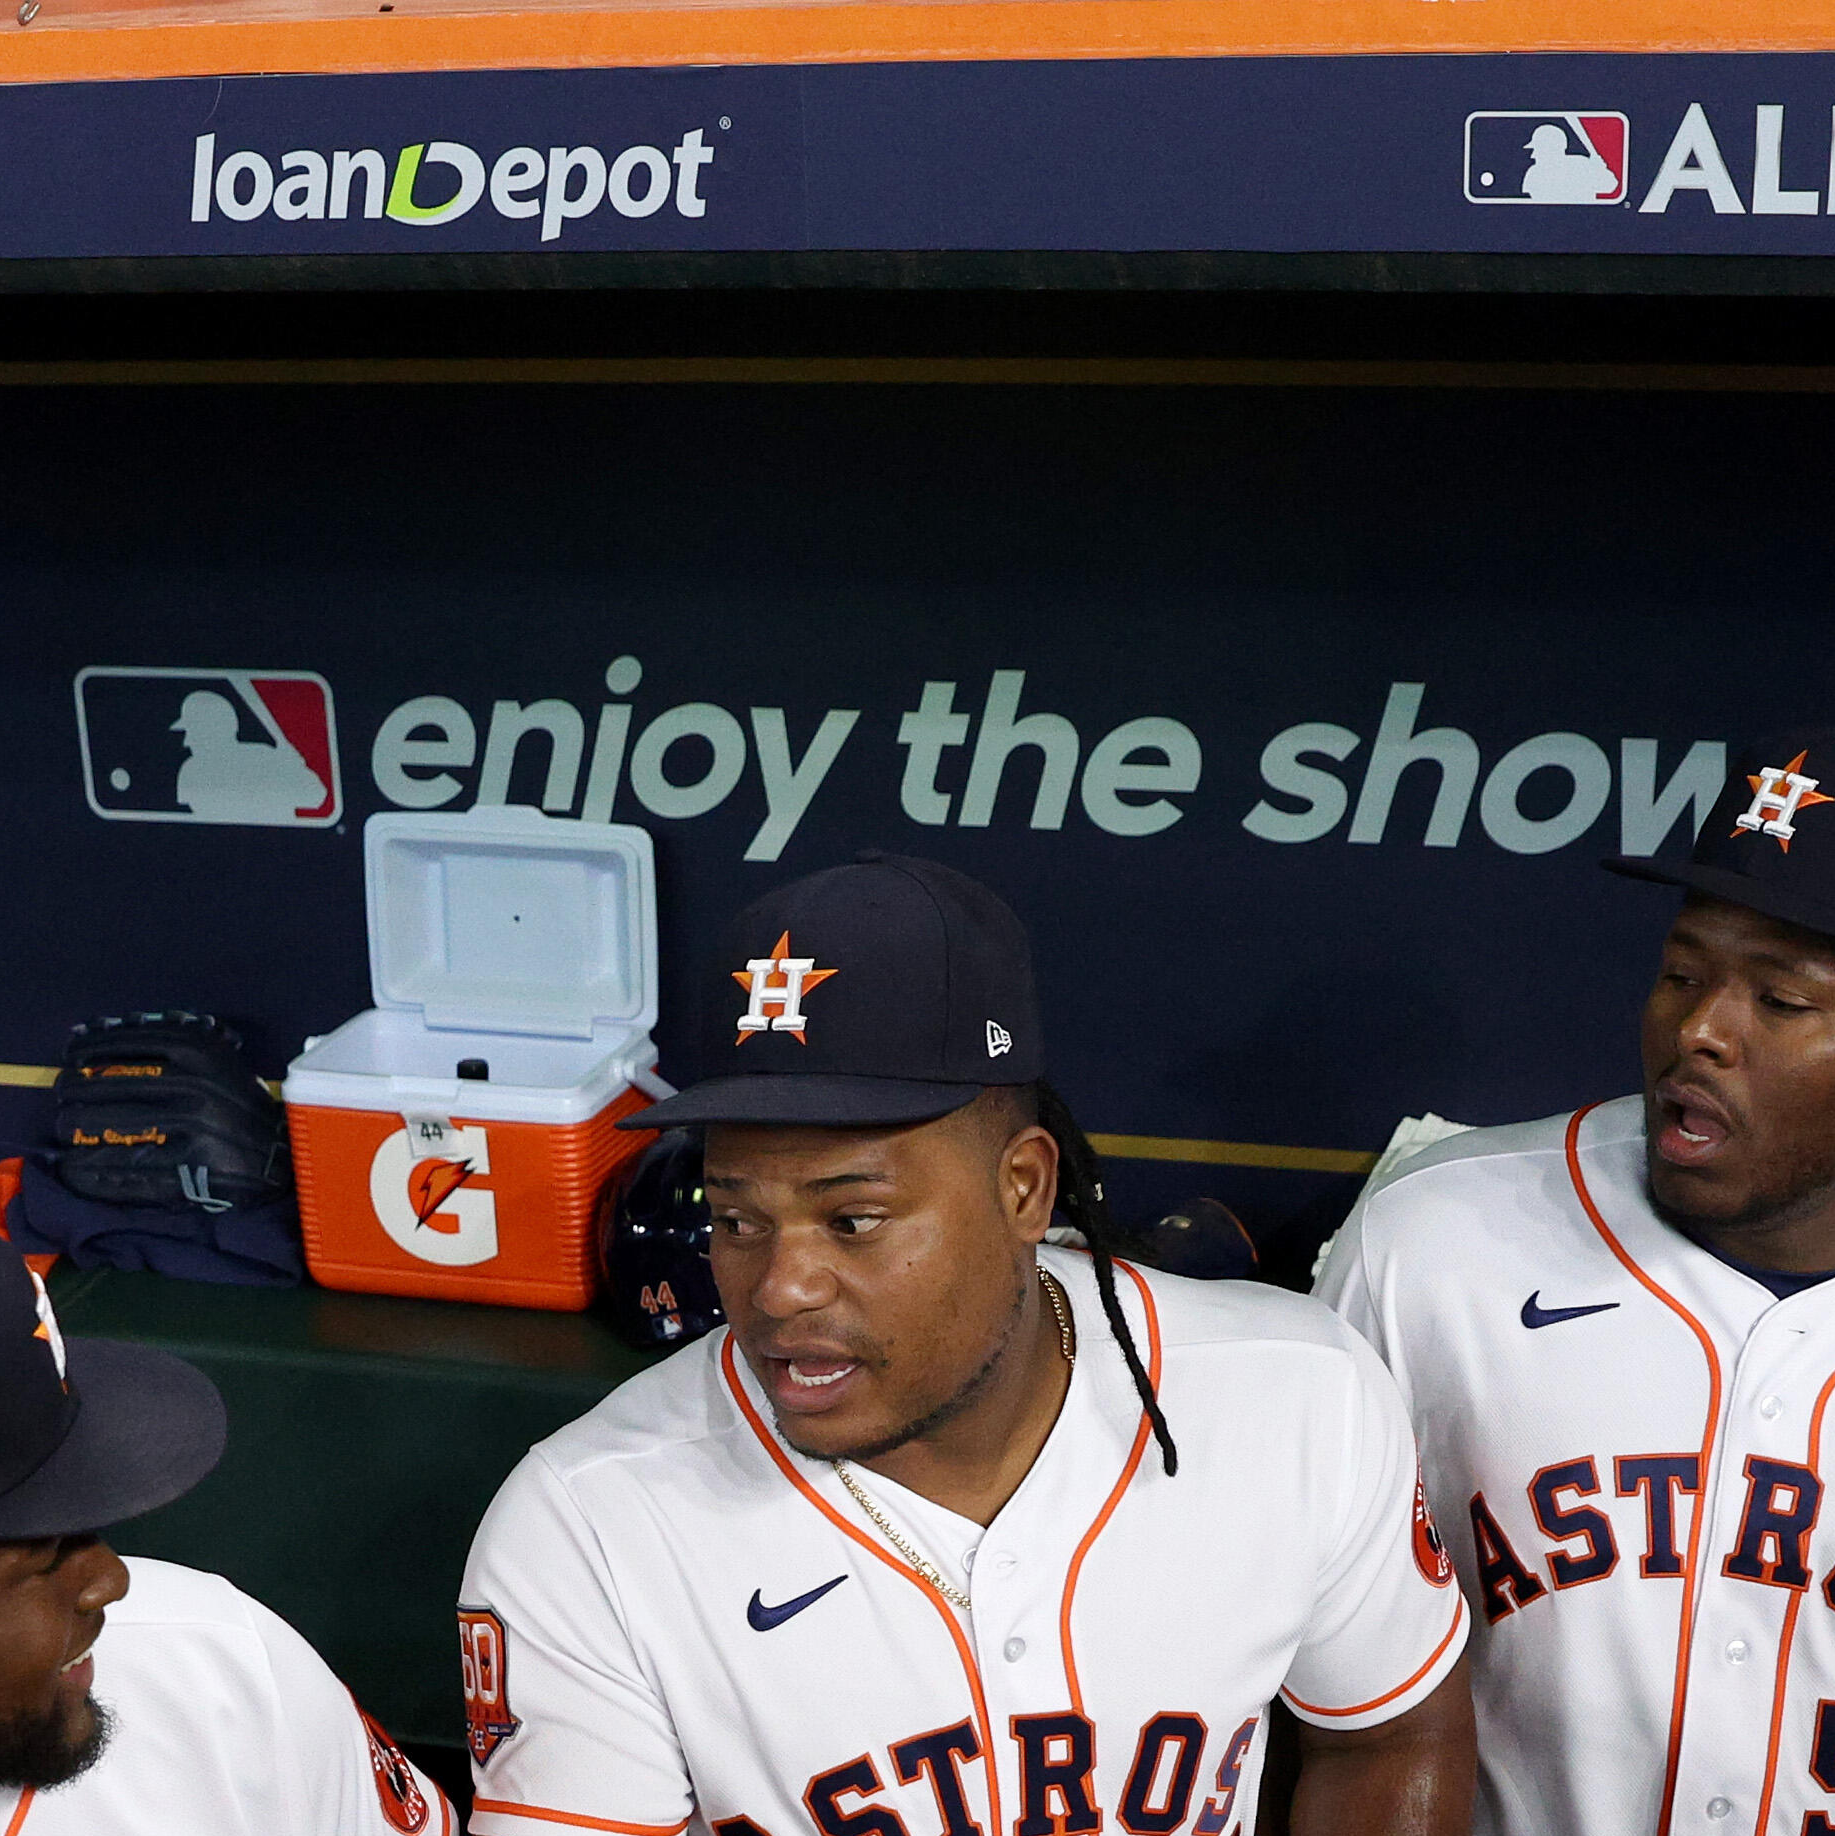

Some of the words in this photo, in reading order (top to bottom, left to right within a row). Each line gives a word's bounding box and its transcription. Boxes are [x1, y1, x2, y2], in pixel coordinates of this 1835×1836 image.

[190, 127, 715, 242] loanDepot
[371, 655, 861, 862] enjoy
[897, 669, 1202, 837] the
[736, 958, 815, 1031] H
[420, 1122, 444, 1141] 44
[640, 1281, 678, 1314] 44
